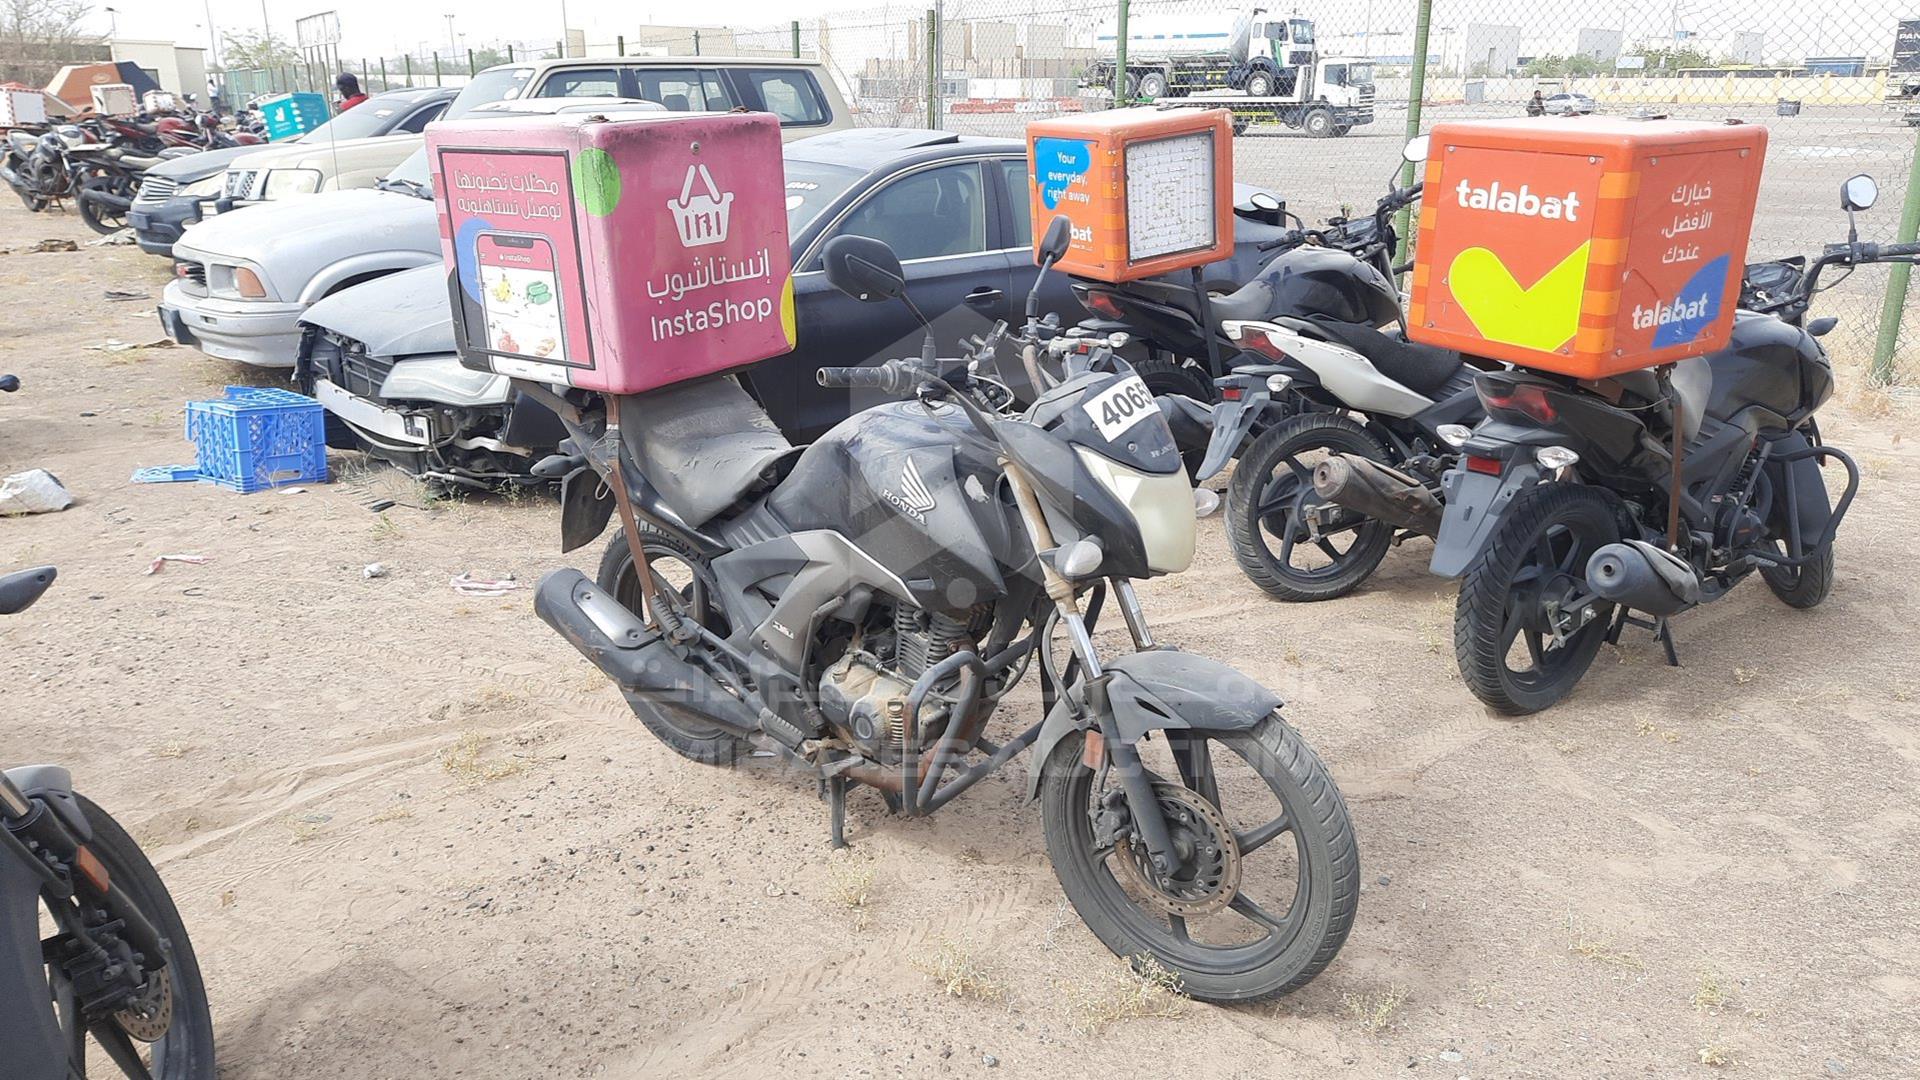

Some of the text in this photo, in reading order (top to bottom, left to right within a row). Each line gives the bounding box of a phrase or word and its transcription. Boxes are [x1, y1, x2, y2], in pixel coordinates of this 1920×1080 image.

[1057, 152, 1076, 165] Your
[1048, 171, 1088, 186] everyday,
[1048, 188, 1090, 205] right away
[1456, 179, 1580, 222] talabat
[1671, 181, 1712, 206] خيارك
[1069, 223, 1092, 242] bat
[1662, 243, 1700, 264] عندك
[647, 247, 770, 304] إنستاشوب
[651, 298, 772, 341] InstaShop
[1632, 292, 1708, 330] talabat
[882, 489, 928, 526] HONDA
